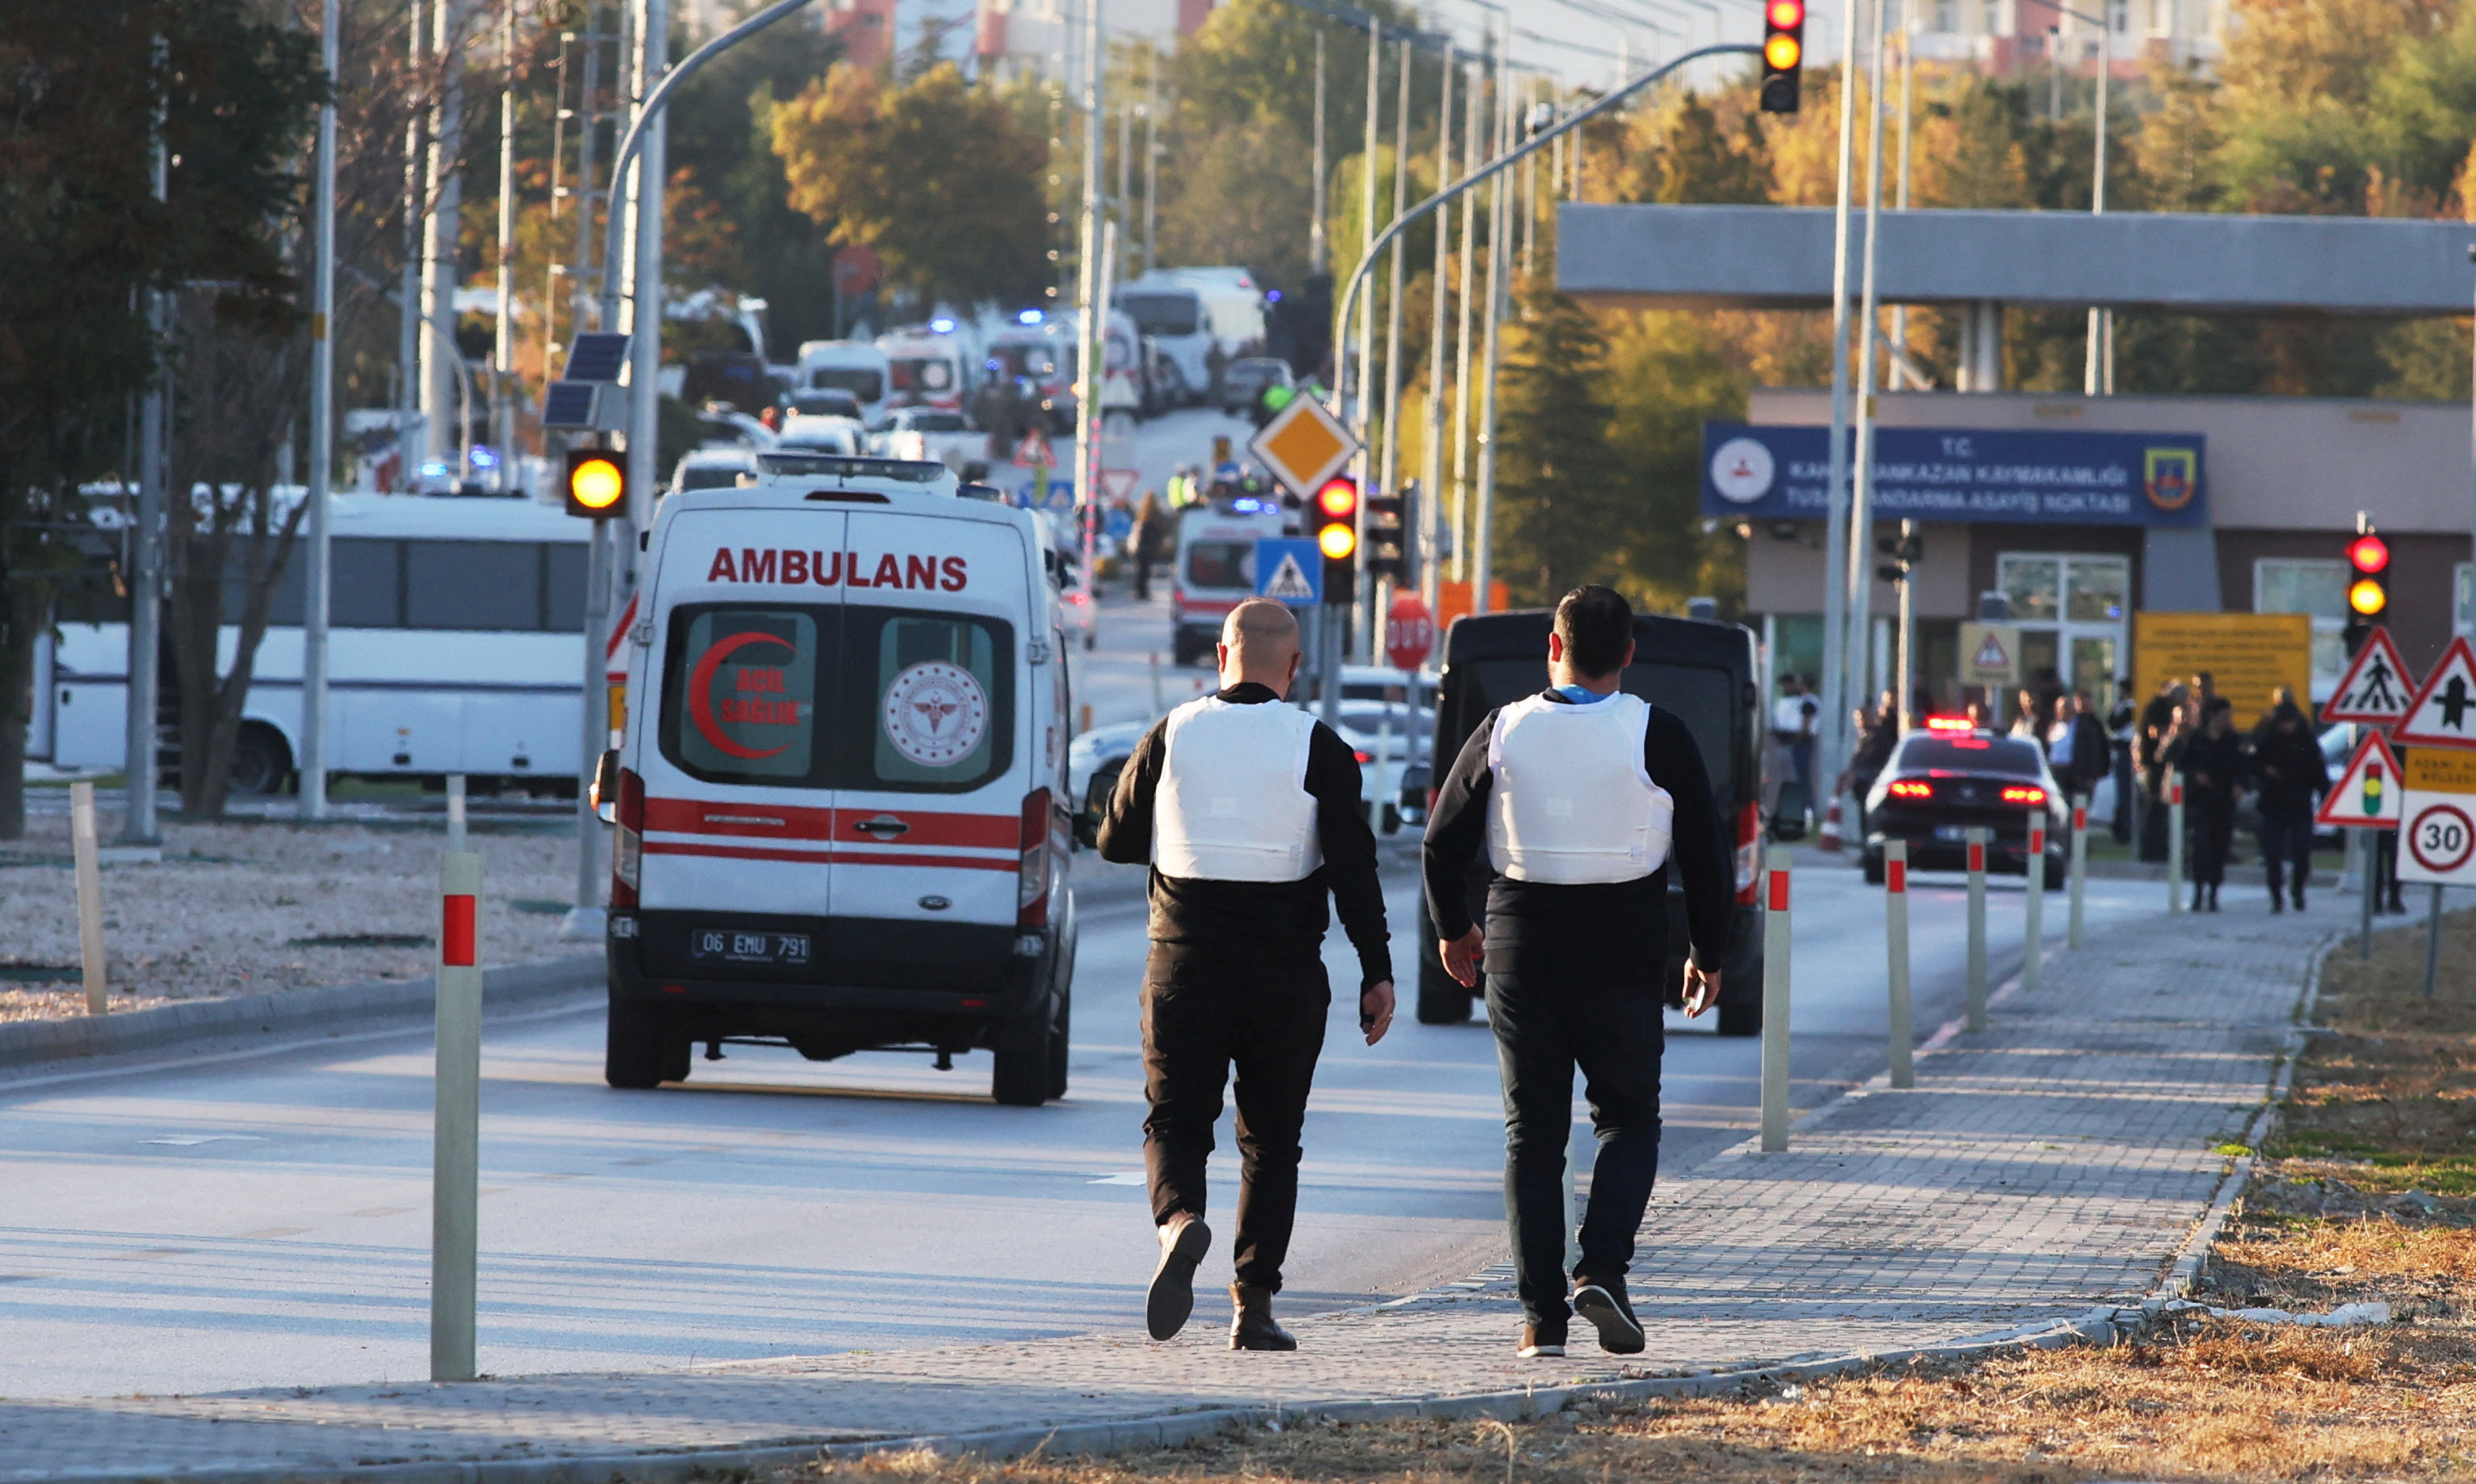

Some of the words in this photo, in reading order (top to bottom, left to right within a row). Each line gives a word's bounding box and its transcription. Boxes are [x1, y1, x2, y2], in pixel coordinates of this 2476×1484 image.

[708, 547, 967, 592] AMBULANS
[1386, 617, 1432, 650] DUR
[736, 665, 785, 693] ACİL
[720, 696, 801, 725] SAĞLIK
[2424, 824, 2461, 851] 30
[703, 933, 724, 952] 06
[734, 934, 767, 955] EMU
[777, 936, 806, 956] 791
